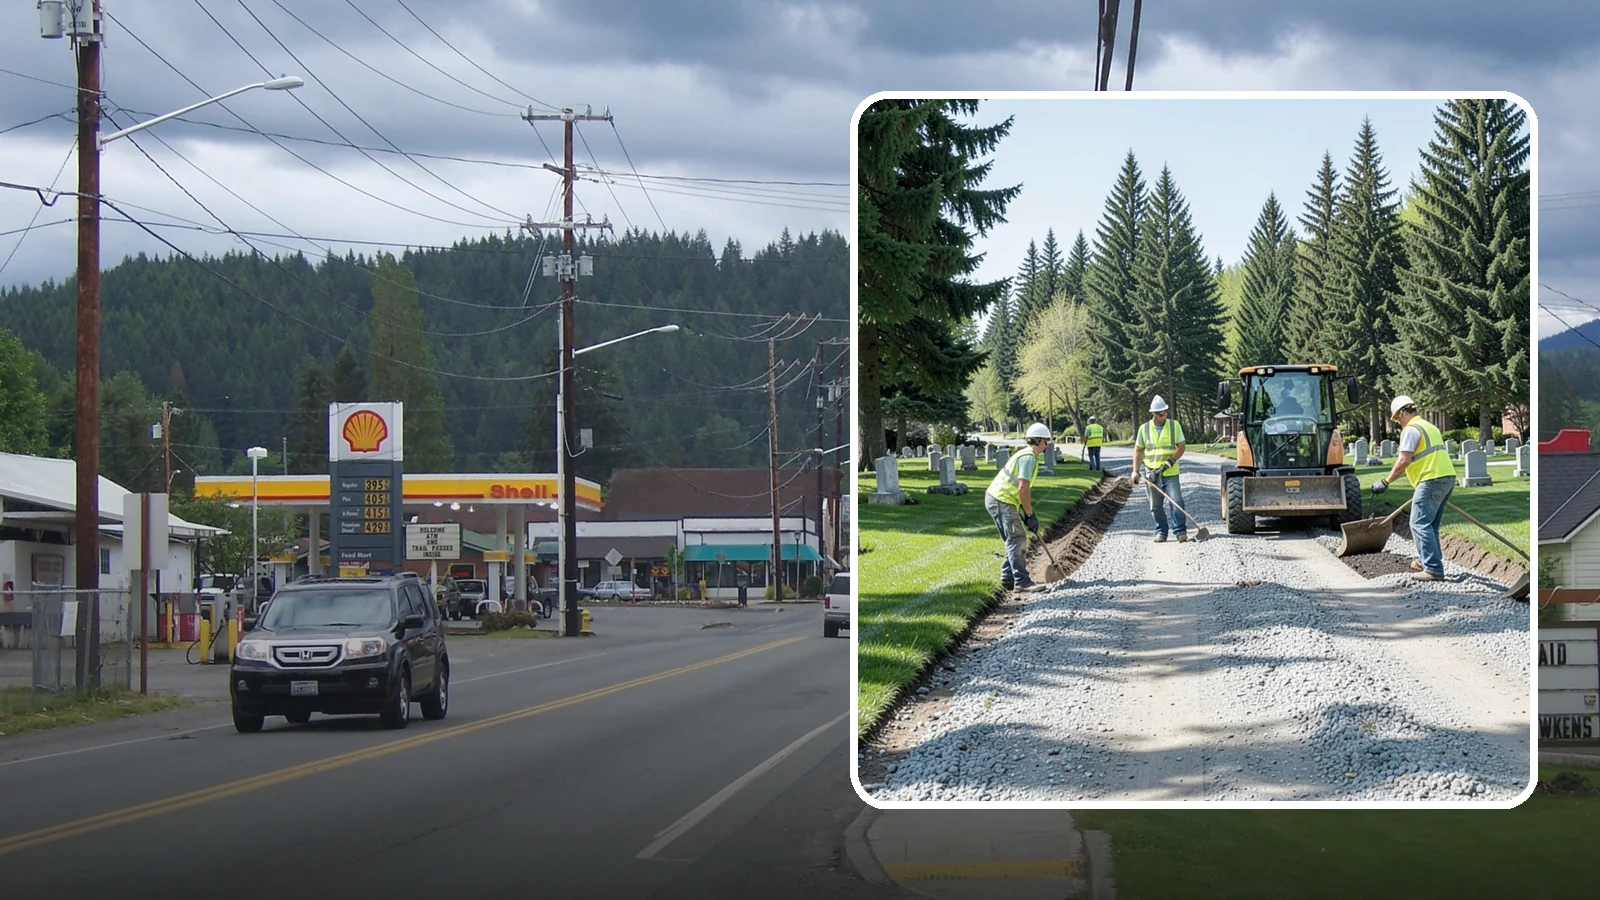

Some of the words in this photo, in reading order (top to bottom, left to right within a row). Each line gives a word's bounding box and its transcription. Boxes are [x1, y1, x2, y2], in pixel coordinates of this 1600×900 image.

[366, 480, 384, 490] 395
[490, 484, 547, 499] Shell
[366, 494, 384, 504] 405
[366, 508, 383, 518] 415
[366, 522, 384, 532] 429
